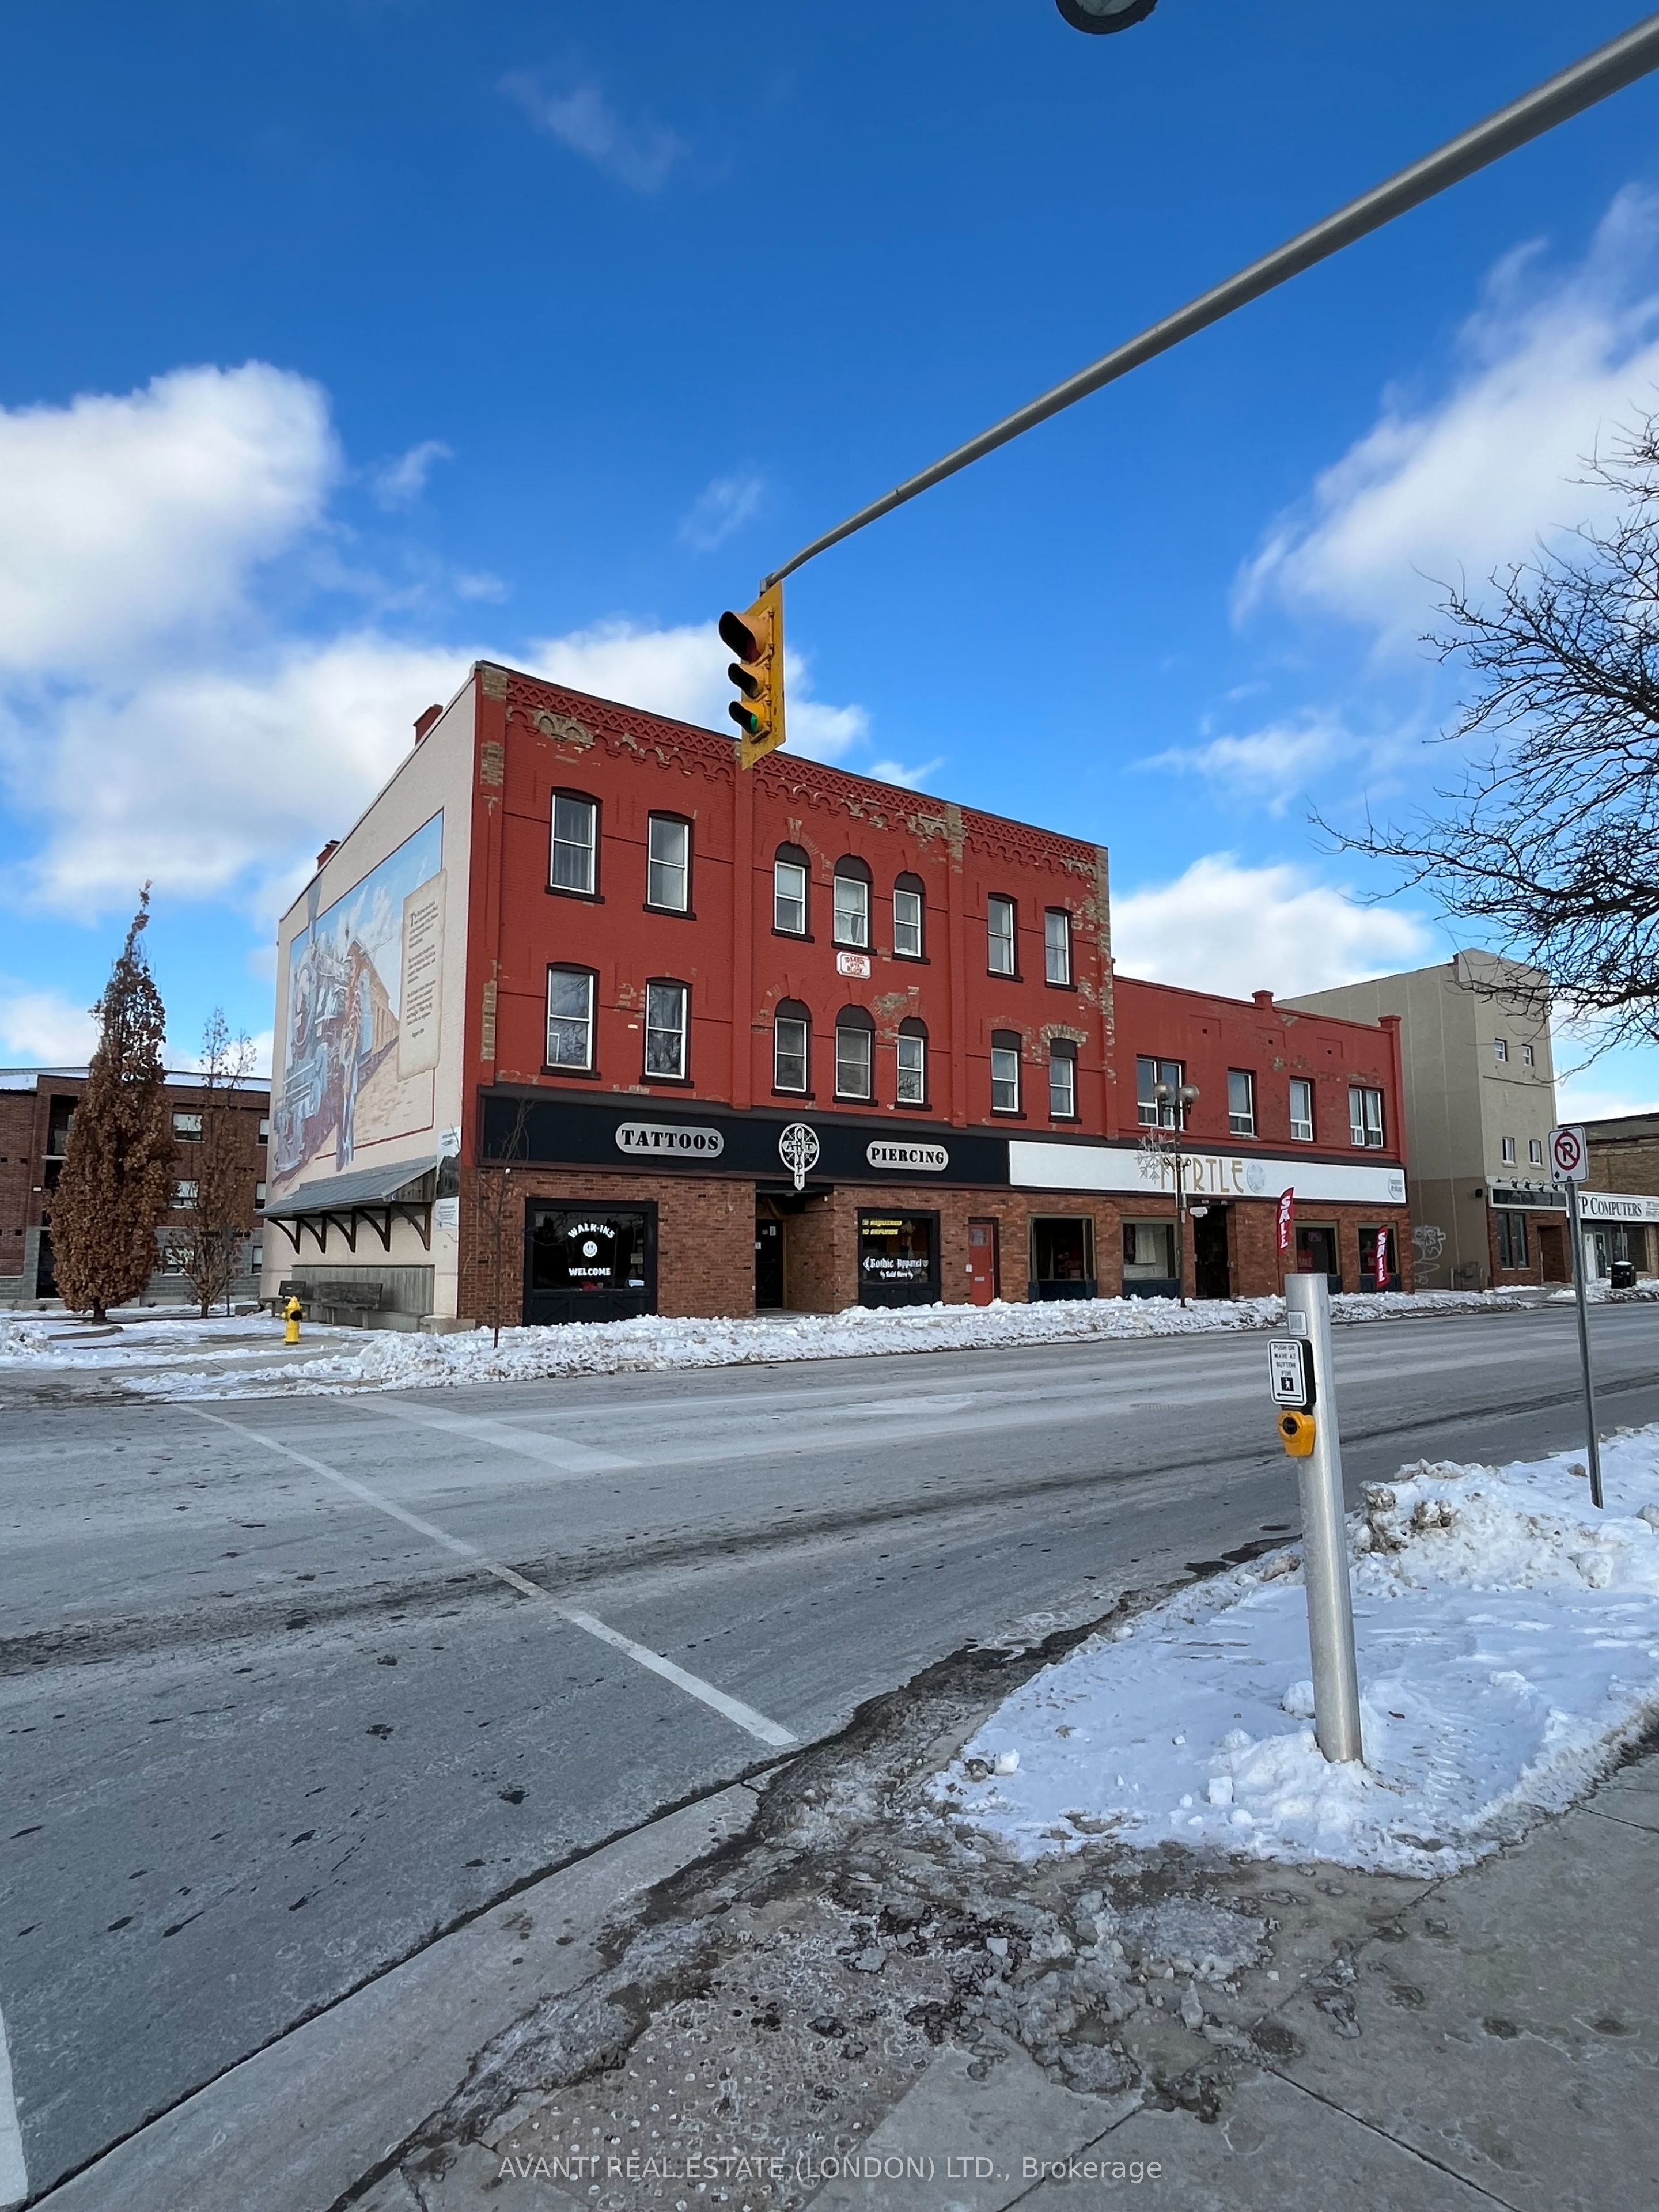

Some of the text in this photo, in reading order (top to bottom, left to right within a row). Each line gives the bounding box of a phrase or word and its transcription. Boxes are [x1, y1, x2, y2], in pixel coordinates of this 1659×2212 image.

[621, 1129, 719, 1151] TATTOOS
[871, 1147, 944, 1164] PIERCING
[568, 1222, 616, 1238] WALK-INS
[1279, 1195, 1291, 1249] SALE
[569, 1268, 611, 1276] WELCOME
